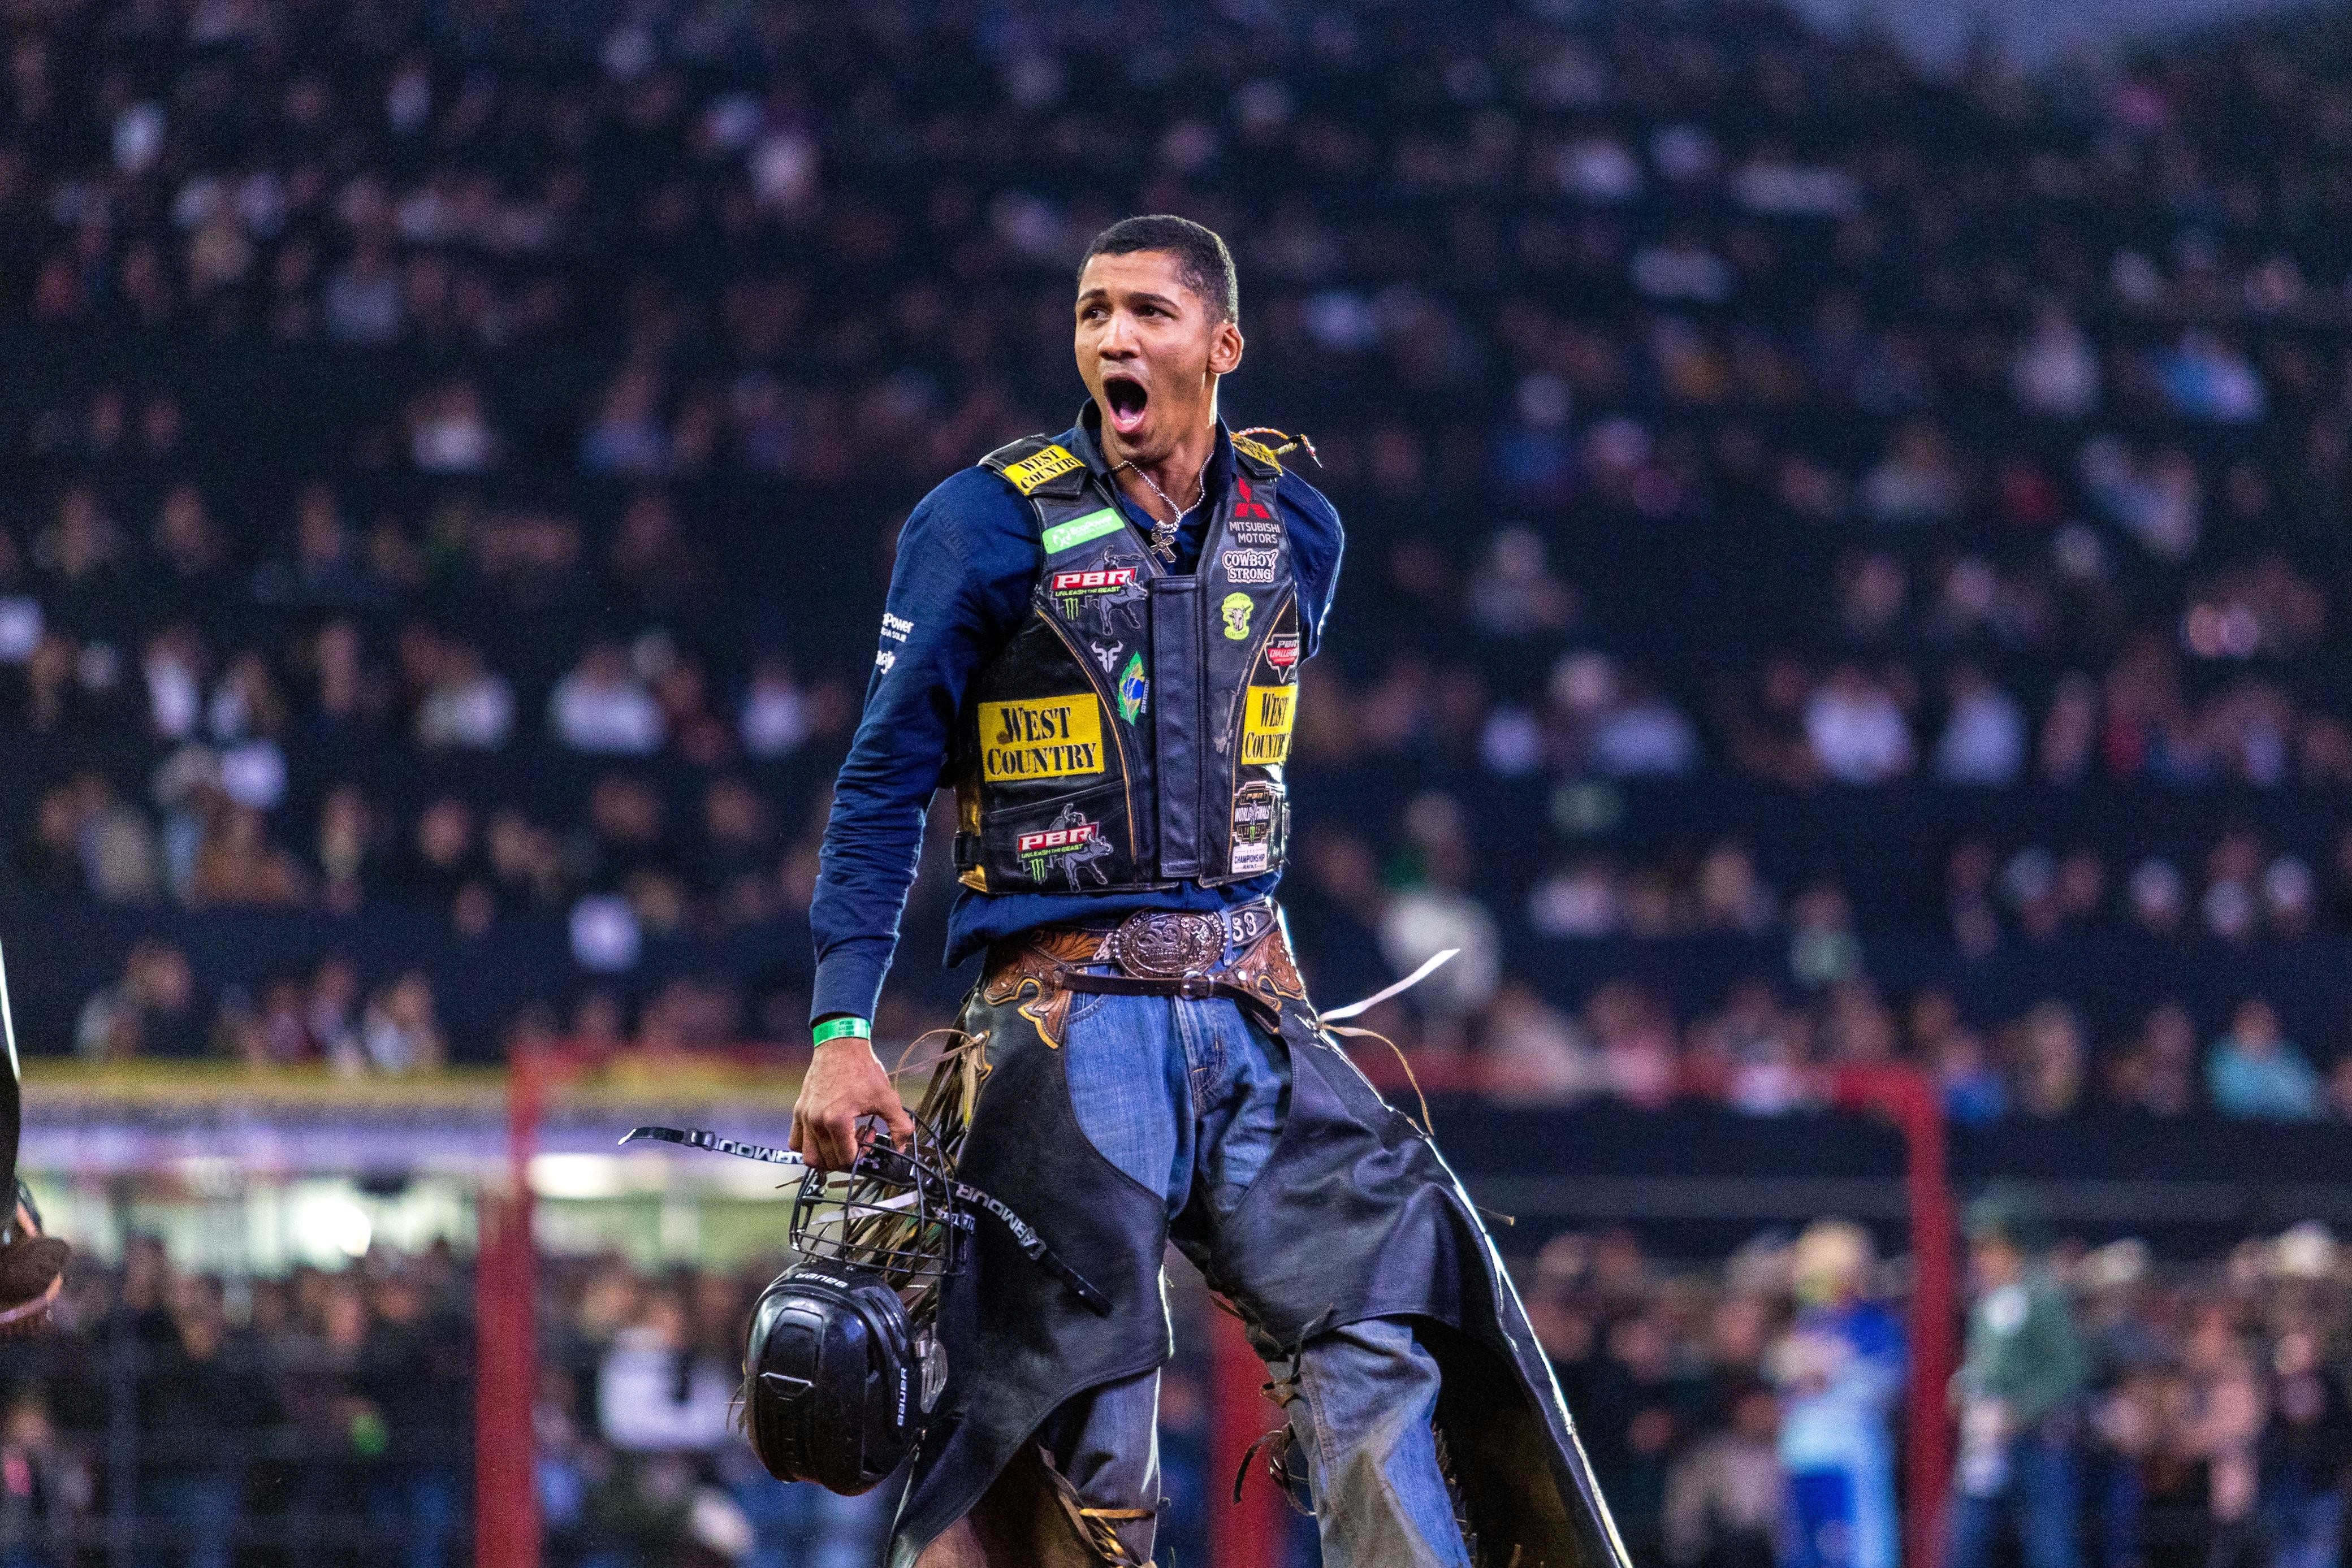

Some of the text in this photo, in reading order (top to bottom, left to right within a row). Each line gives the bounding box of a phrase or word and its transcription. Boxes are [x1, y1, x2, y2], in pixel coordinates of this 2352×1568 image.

[1019, 449, 1060, 471] WEST
[1021, 457, 1082, 489] COUNTRY
[1229, 521, 1281, 533] MITSUBISHI
[1238, 533, 1278, 544] MOTORS
[1223, 552, 1277, 566] COWBOY
[1057, 570, 1131, 588] PBR
[1229, 568, 1272, 580] STRONG
[1261, 693, 1289, 727] WEST
[1001, 707, 1071, 742] WEST
[988, 743, 1097, 775] COUNTRY
[1022, 827, 1092, 850] PBR
[1021, 850, 1051, 859] UNLEASH
[1061, 844, 1083, 852] BEAST
[1234, 854, 1265, 864] CHAMPIONSHIP
